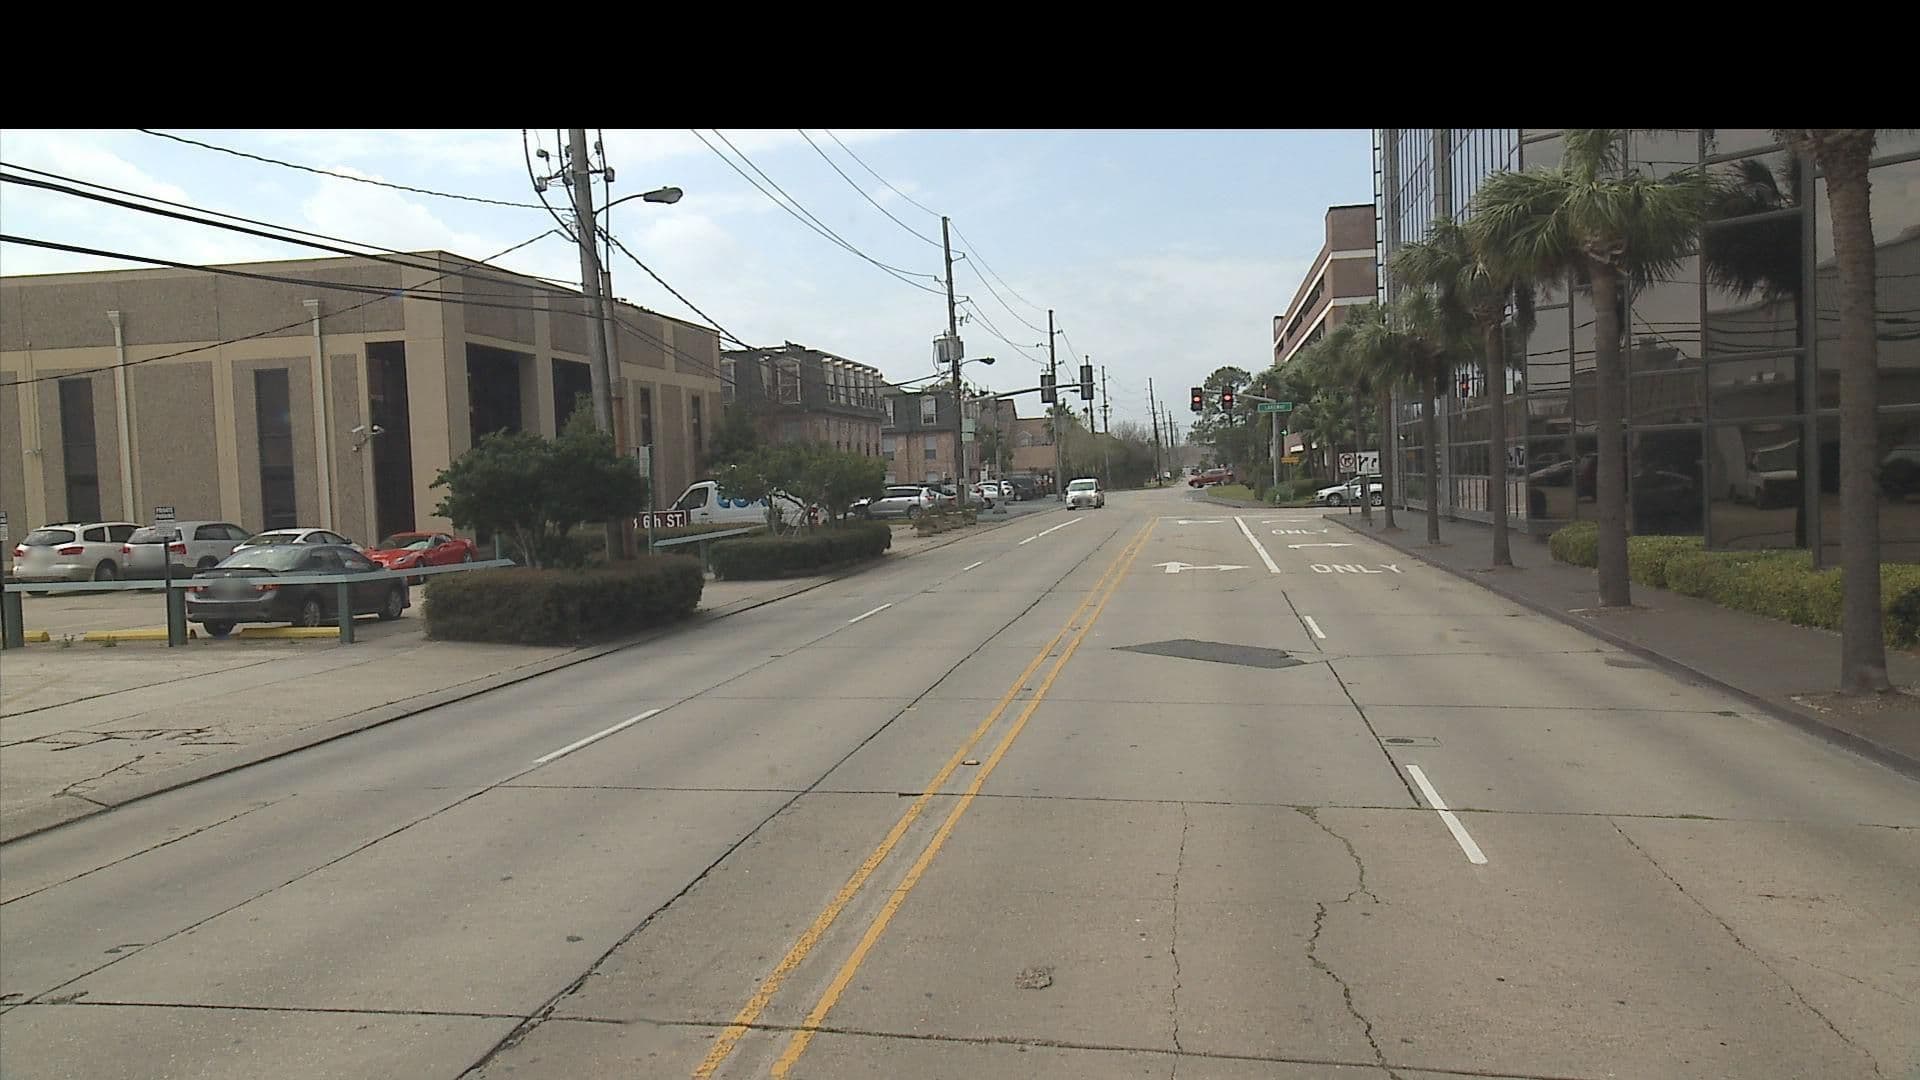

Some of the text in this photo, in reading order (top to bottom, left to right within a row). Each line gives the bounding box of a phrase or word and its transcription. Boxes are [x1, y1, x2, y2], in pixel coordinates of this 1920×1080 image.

[643, 514, 661, 529] 6h
[667, 513, 683, 528] ST.
[1310, 563, 1402, 574] ONLY
